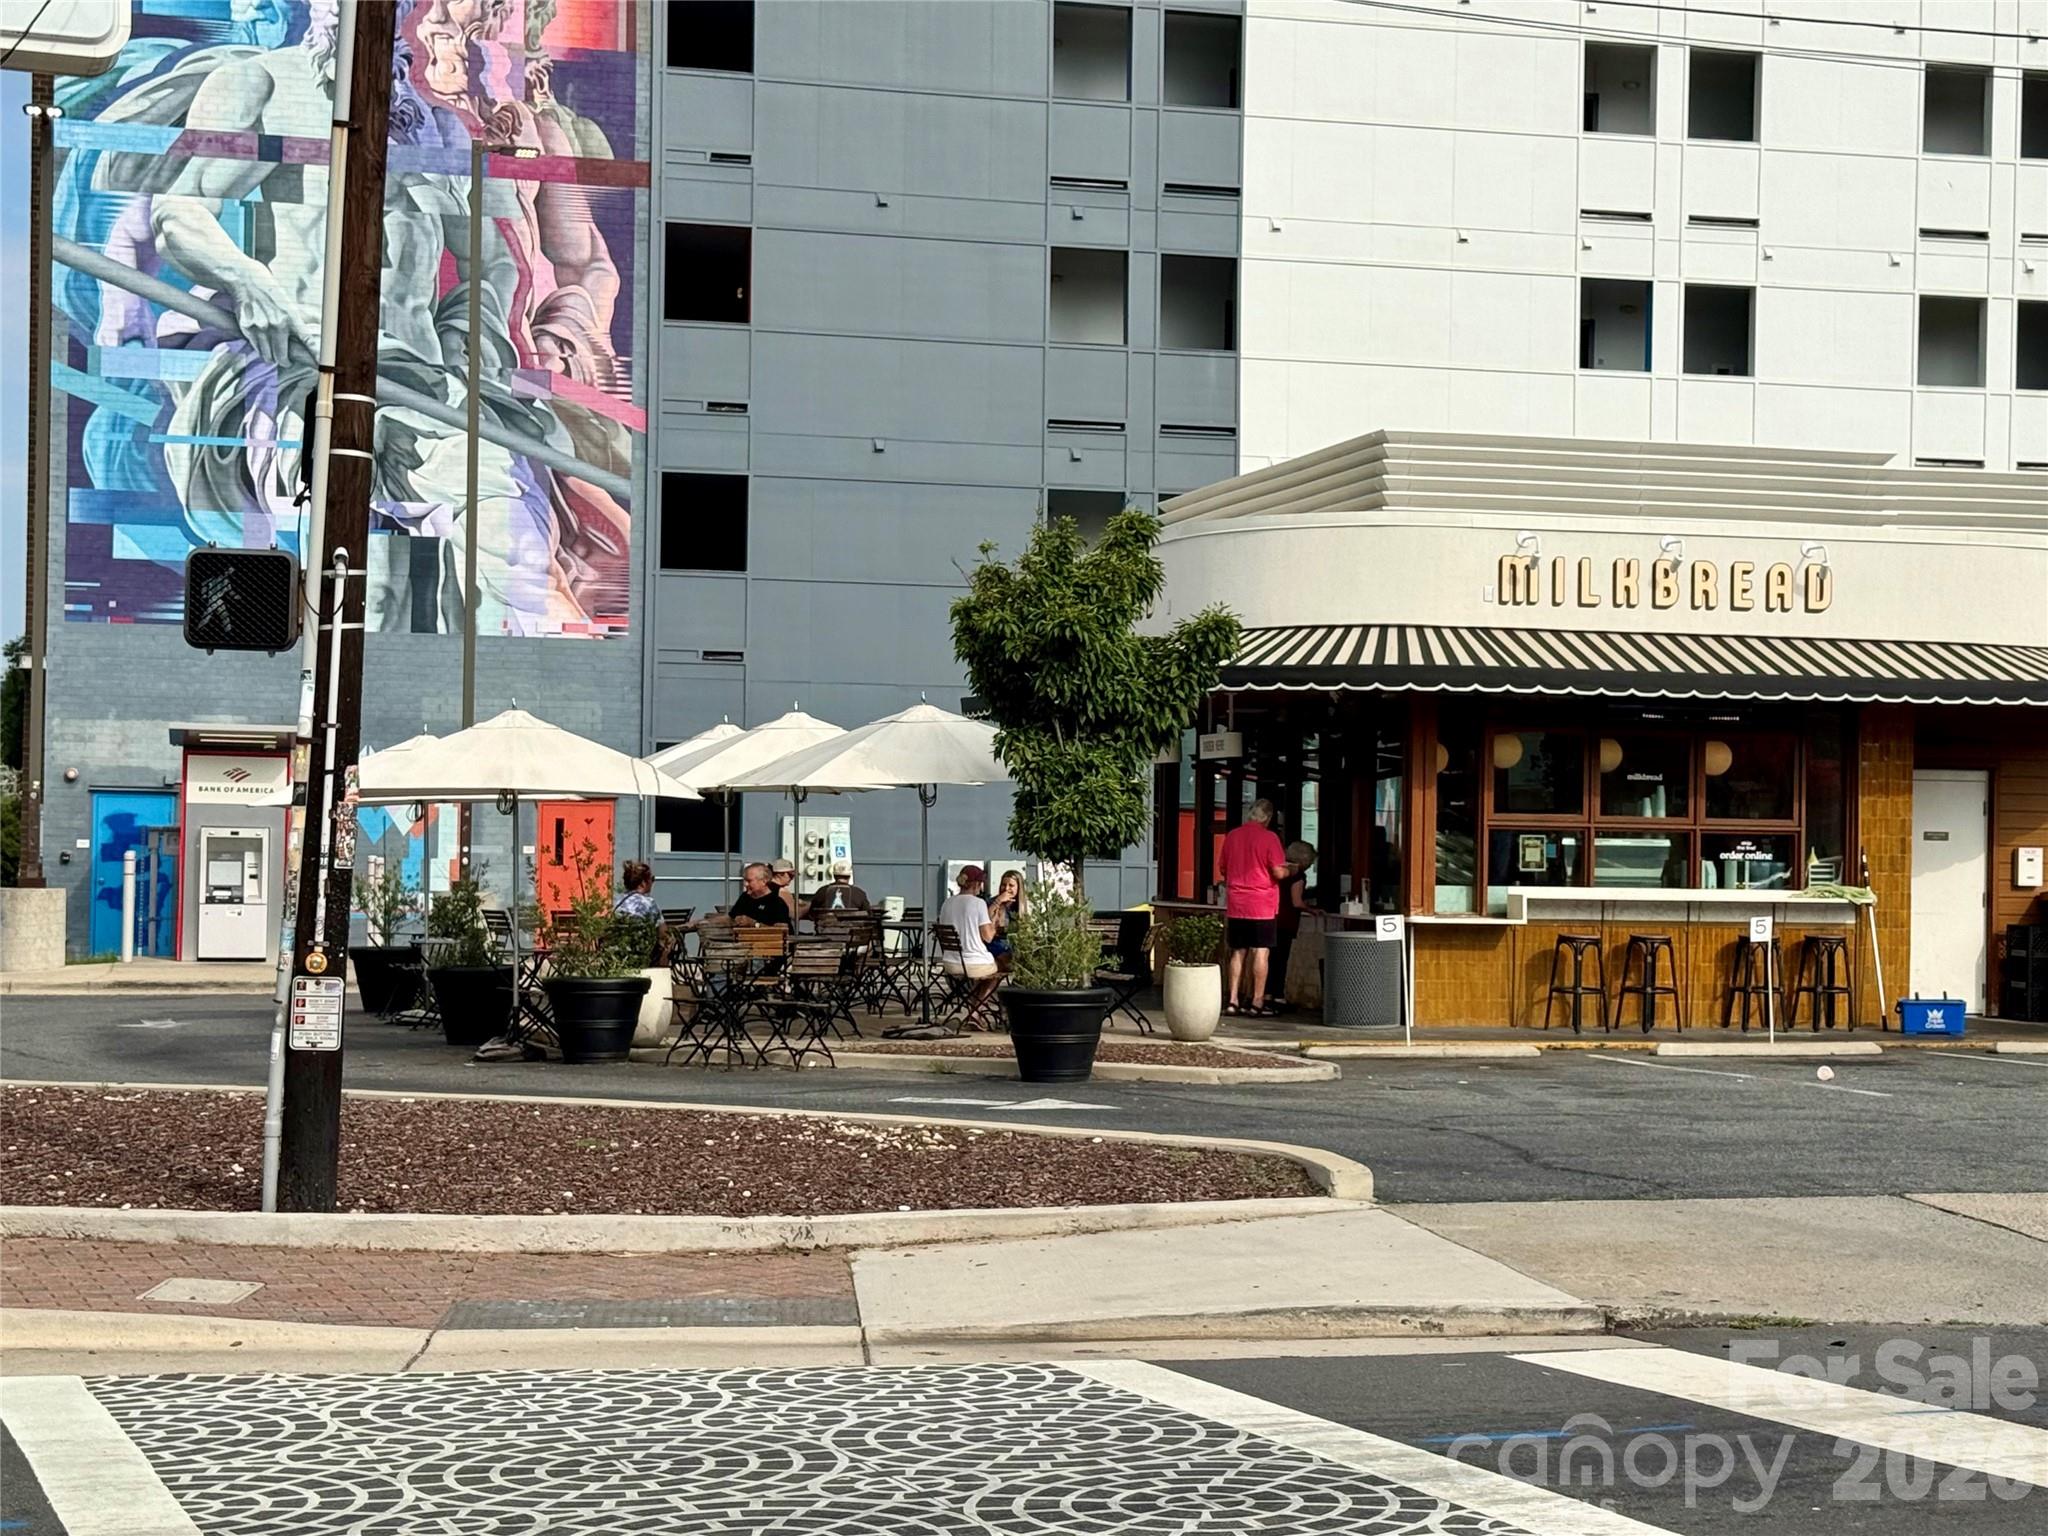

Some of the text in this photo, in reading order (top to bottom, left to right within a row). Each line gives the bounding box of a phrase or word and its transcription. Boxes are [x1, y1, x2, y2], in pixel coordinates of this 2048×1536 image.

[1498, 554, 1833, 613] MILKBREAD
[1719, 851, 1773, 860] order online
[1382, 917, 1397, 933] 5
[1755, 919, 1767, 934] 5
